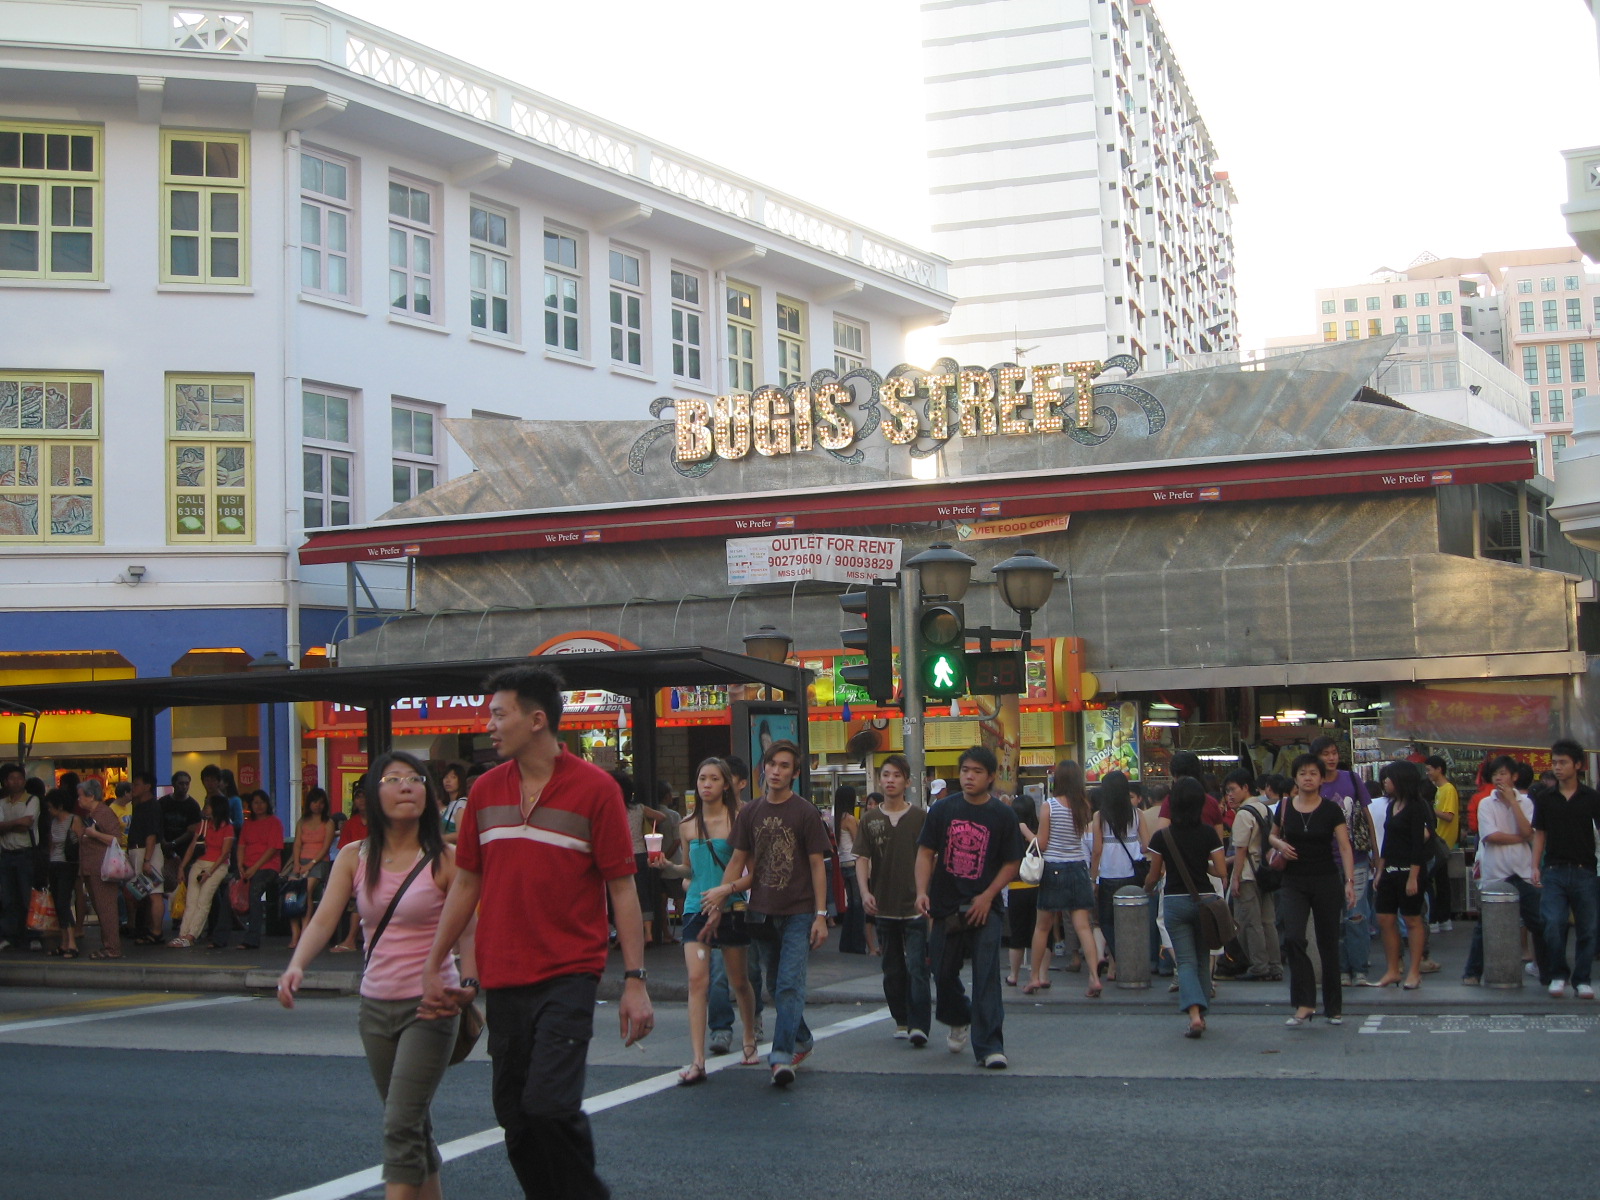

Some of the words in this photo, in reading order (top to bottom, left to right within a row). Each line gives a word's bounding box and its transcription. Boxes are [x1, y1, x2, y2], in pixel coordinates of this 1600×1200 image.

[674, 383, 854, 463] BUGIS
[879, 360, 1101, 444] STREET
[1382, 476, 1397, 485] We
[1399, 474, 1426, 484] Prefer
[177, 495, 204, 504] CALL
[221, 495, 240, 504] US!
[1153, 492, 1167, 500] We
[1169, 490, 1194, 500] Prefer
[177, 507, 204, 516] 6336
[218, 507, 244, 516] 1898
[938, 507, 951, 515] We
[952, 505, 977, 515] Prefer
[735, 520, 748, 529] We
[749, 518, 772, 528] Prefer
[974, 526, 995, 535] VIET
[998, 523, 1027, 533] FOOD
[545, 534, 557, 543] We
[558, 532, 579, 542] Prefer
[367, 547, 379, 556] We
[380, 545, 400, 555] Prefer
[771, 536, 824, 552] OUTLET
[827, 538, 854, 551] FOR
[858, 540, 895, 555] RENT
[768, 553, 822, 567] 90279609
[834, 556, 894, 570] 90093829
[846, 571, 865, 579] MISS
